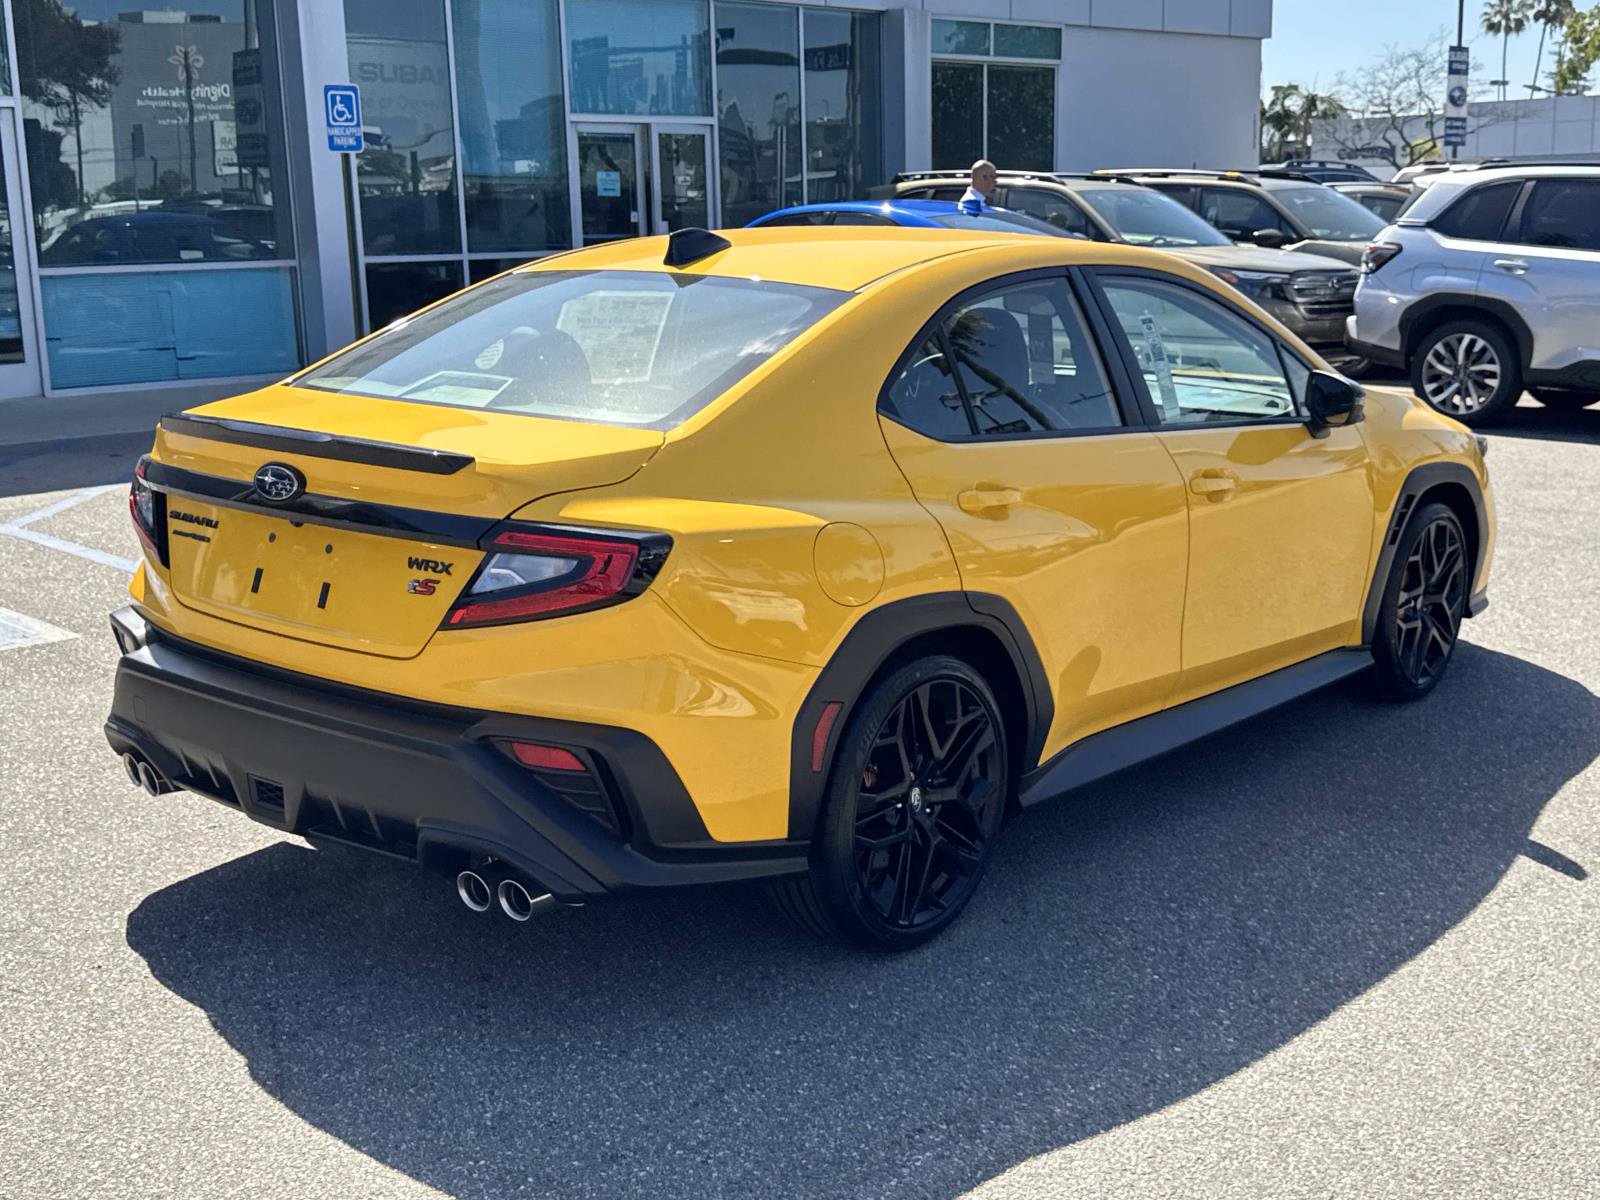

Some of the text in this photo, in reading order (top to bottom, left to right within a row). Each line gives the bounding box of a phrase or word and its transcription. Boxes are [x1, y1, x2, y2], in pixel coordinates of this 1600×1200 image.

[334, 135, 357, 146] PARKING
[169, 510, 219, 529] SUBARU
[408, 556, 454, 576] WRX
